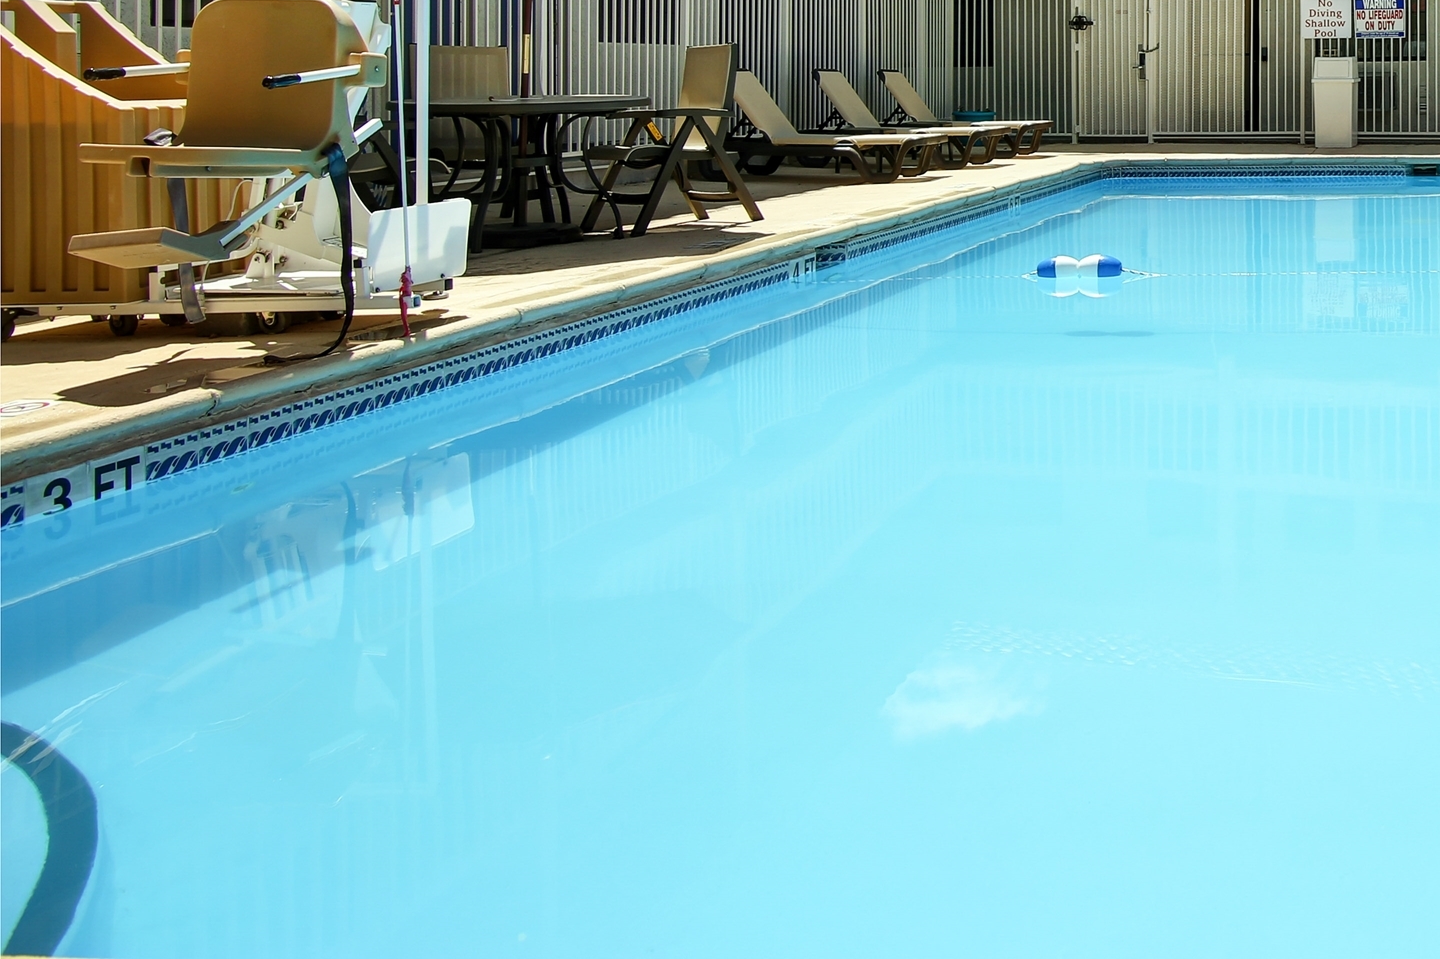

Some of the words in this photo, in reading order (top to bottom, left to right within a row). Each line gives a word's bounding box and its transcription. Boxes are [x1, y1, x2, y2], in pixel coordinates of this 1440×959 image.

[1318, 0, 1333, 7] No
[1363, 0, 1397, 9] WARNING
[1309, 9, 1342, 19] Diving
[1356, 10, 1366, 20] NO
[1369, 10, 1404, 20] LIFEGUARD
[1305, 19, 1346, 28] Shallow
[1365, 21, 1374, 30] ON
[1378, 21, 1396, 30] DUTY
[1314, 29, 1337, 38] Pool
[793, 261, 800, 278] 4
[804, 256, 815, 275] FT
[43, 477, 73, 516] 3
[94, 455, 141, 501] FT
